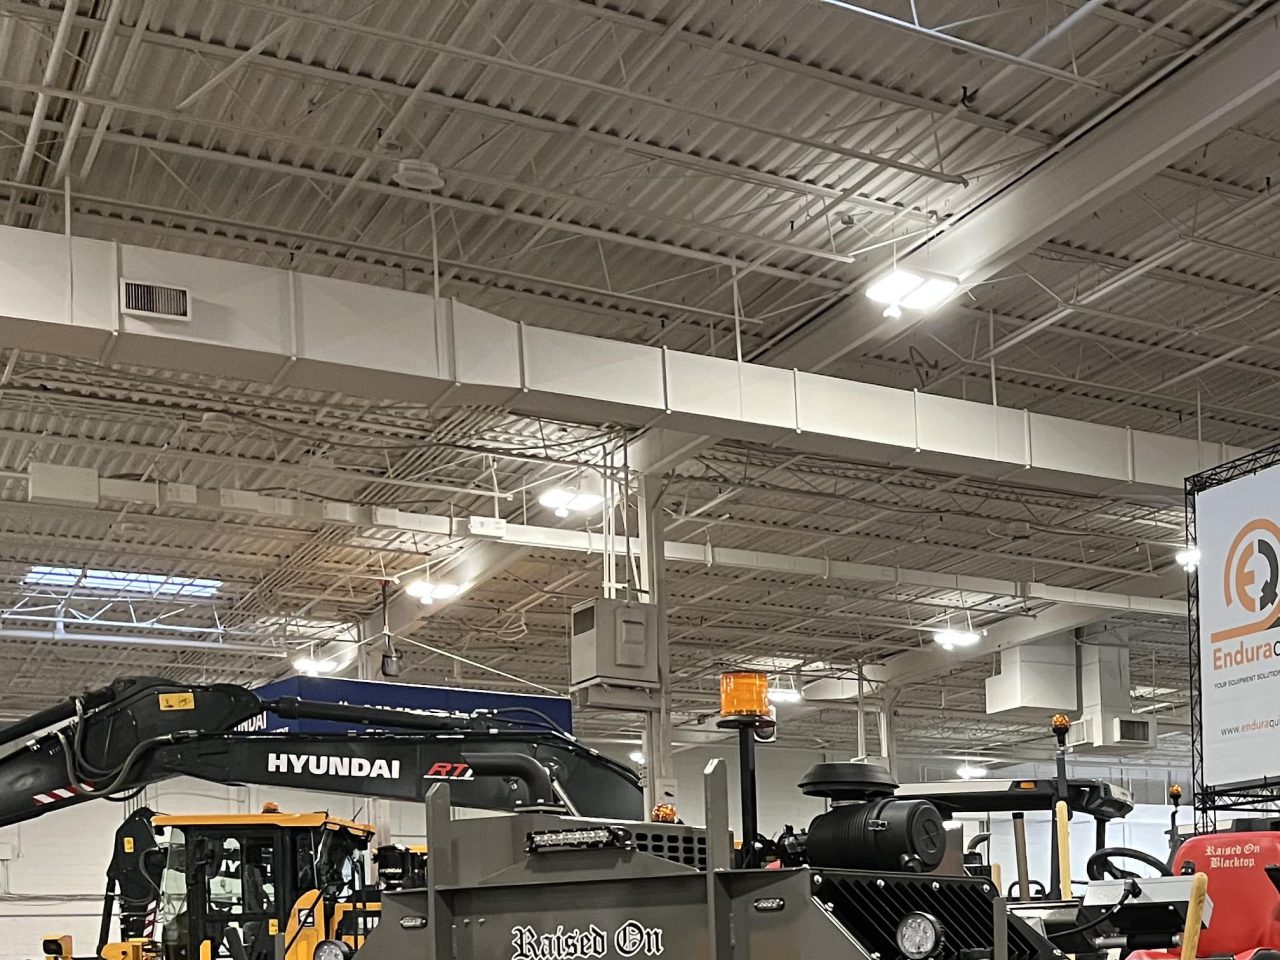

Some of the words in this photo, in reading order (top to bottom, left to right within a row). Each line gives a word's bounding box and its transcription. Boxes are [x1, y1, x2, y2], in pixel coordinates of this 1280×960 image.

[1228, 675, 1256, 687] EQUIPMENT
[267, 753, 400, 779] HYUNDAI
[1205, 845, 1242, 856] Raised
[1243, 843, 1260, 855] On
[1210, 857, 1255, 869] Blacktop
[614, 919, 664, 957] On
